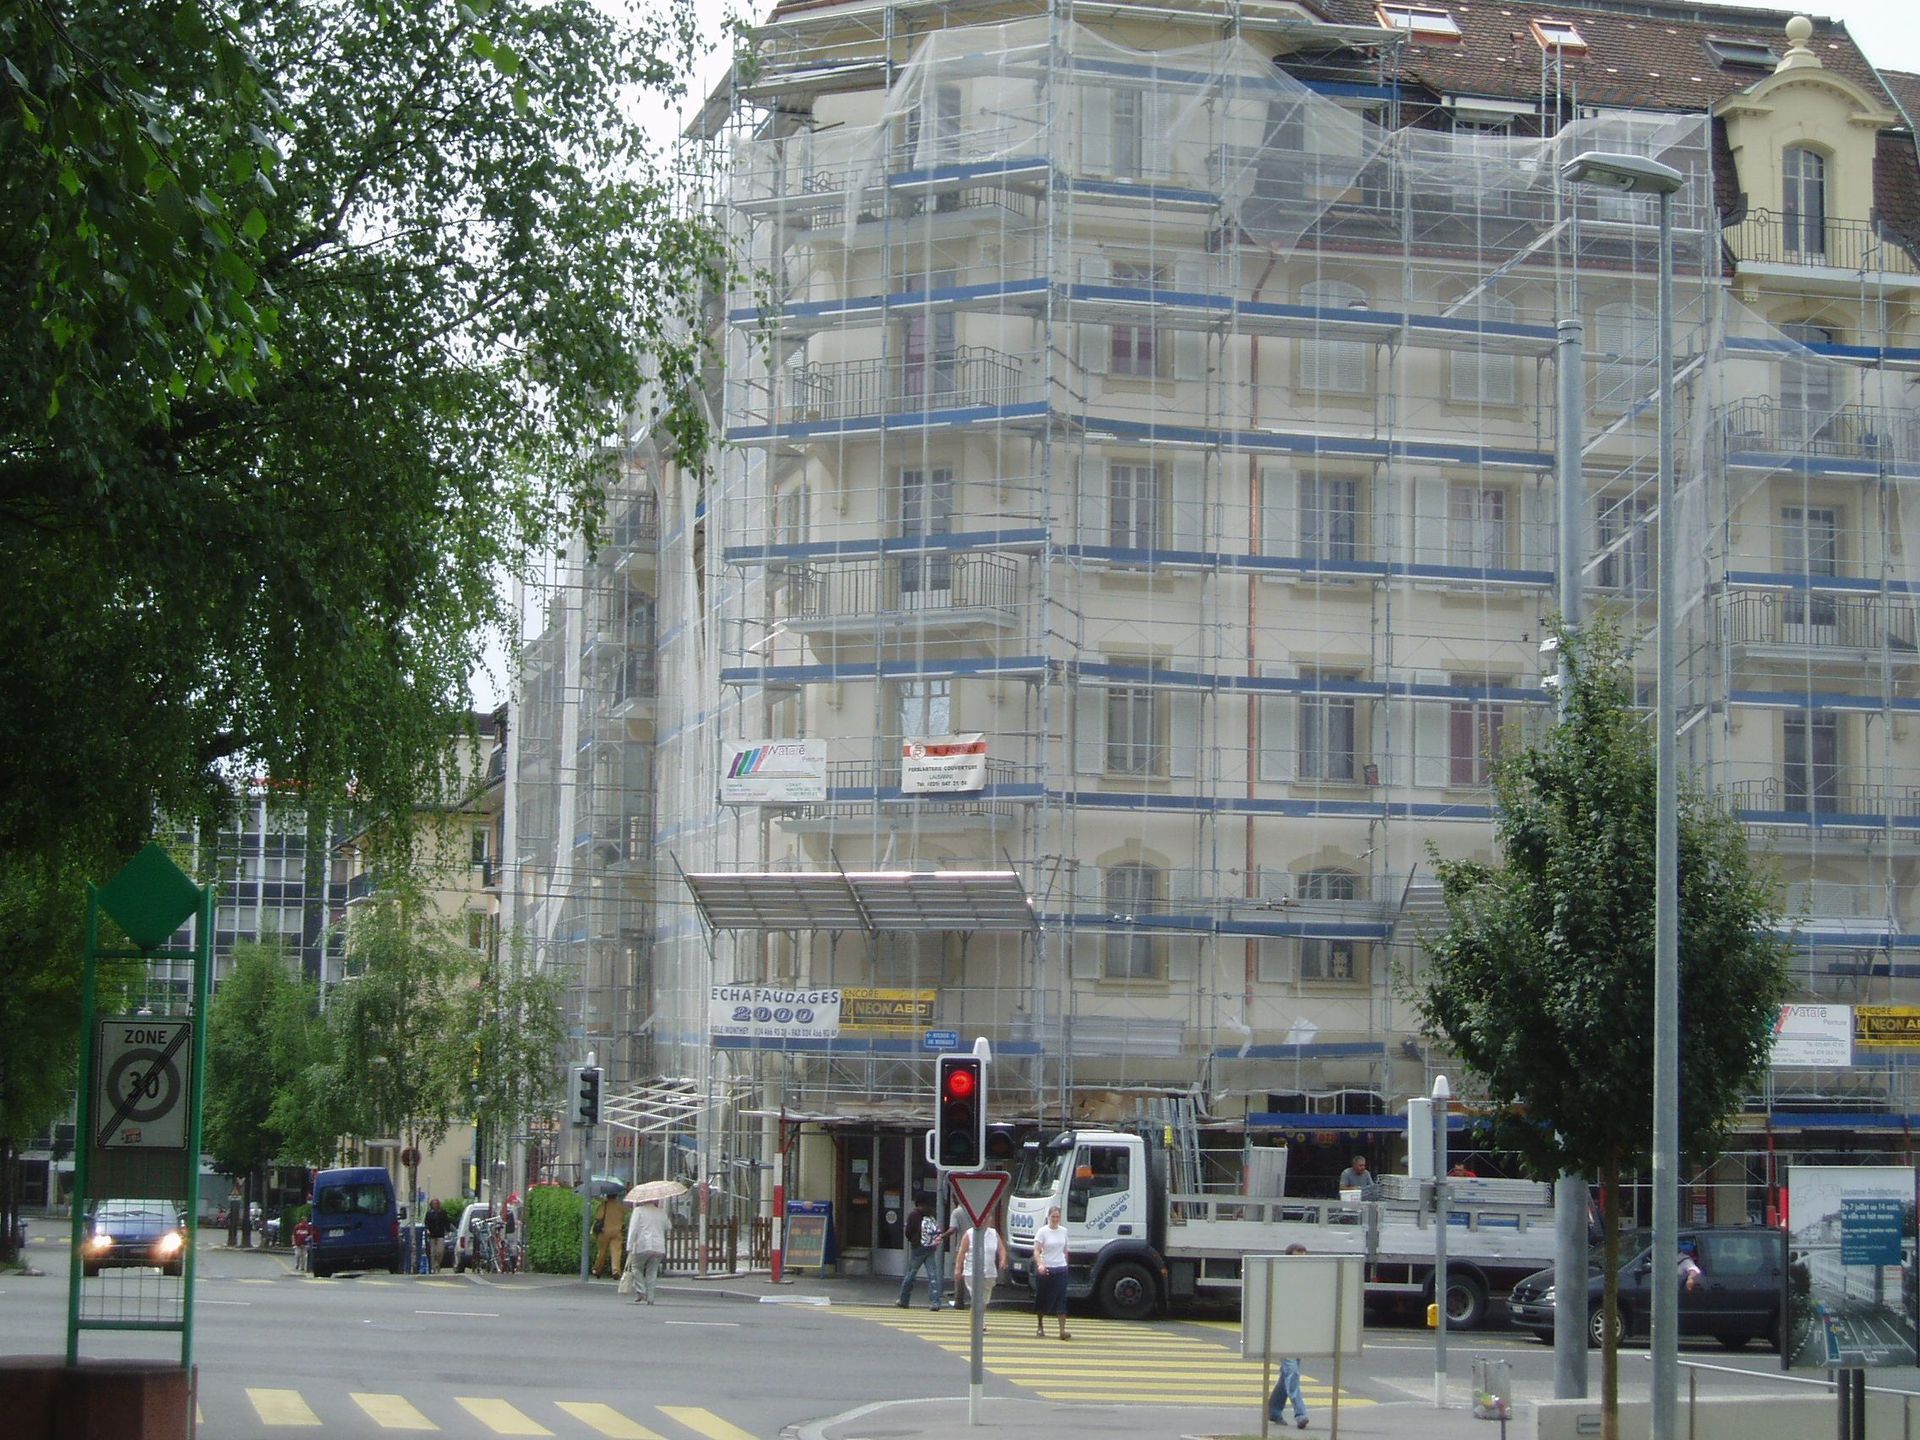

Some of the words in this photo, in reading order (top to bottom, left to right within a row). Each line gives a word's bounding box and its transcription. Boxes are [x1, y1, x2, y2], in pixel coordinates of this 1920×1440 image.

[711, 988, 839, 1004] ECHAFAUDAGES
[844, 989, 879, 998] ENCORE
[732, 1006, 814, 1024] 2000
[856, 1002, 892, 1014] NEON
[893, 1003, 926, 1013] ABC
[1789, 1006, 1827, 1018] Natale
[1871, 1019, 1905, 1031] NEON
[125, 1030, 167, 1044] ZONE
[128, 1071, 159, 1099] 30
[1086, 1193, 1130, 1229] ECHAFAUDAGES
[1098, 1203, 1127, 1230] 2000
[1010, 1213, 1034, 1228] 2000
